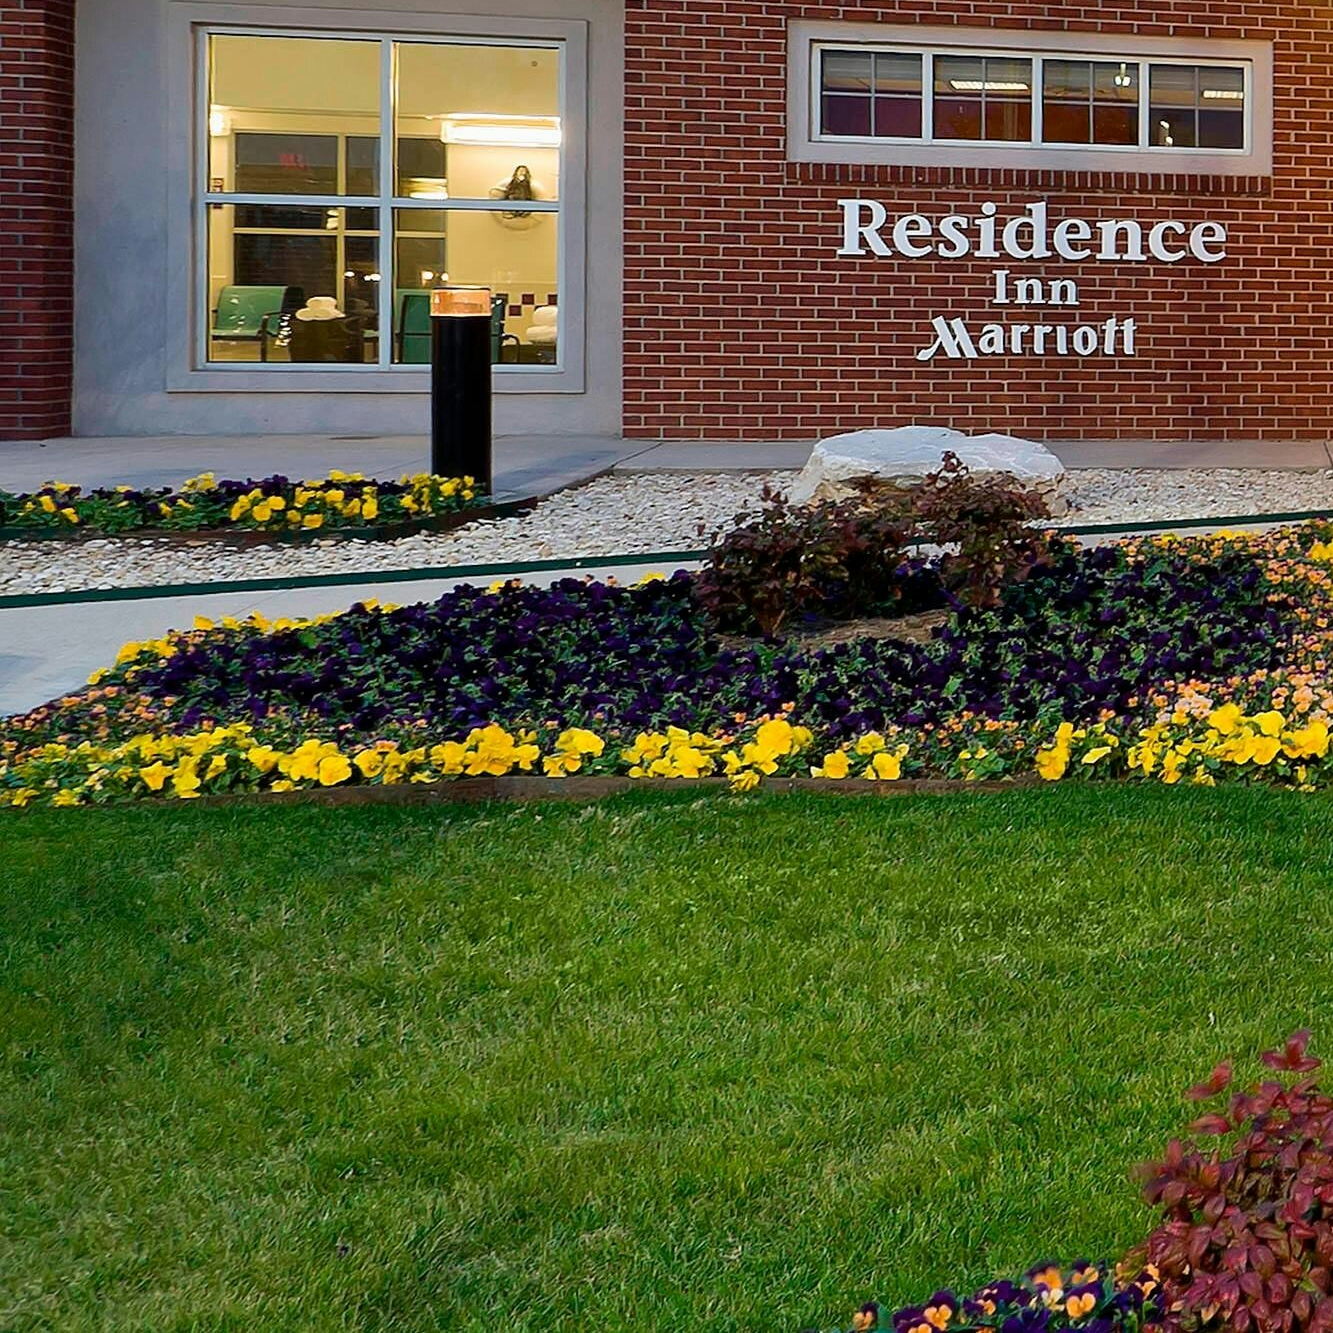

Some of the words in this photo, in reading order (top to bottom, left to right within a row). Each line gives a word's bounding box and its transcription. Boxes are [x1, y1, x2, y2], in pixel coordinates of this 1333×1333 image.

[836, 198, 1227, 263] Residence
[991, 270, 1080, 305] Inn
[915, 315, 1137, 361] Marriott
